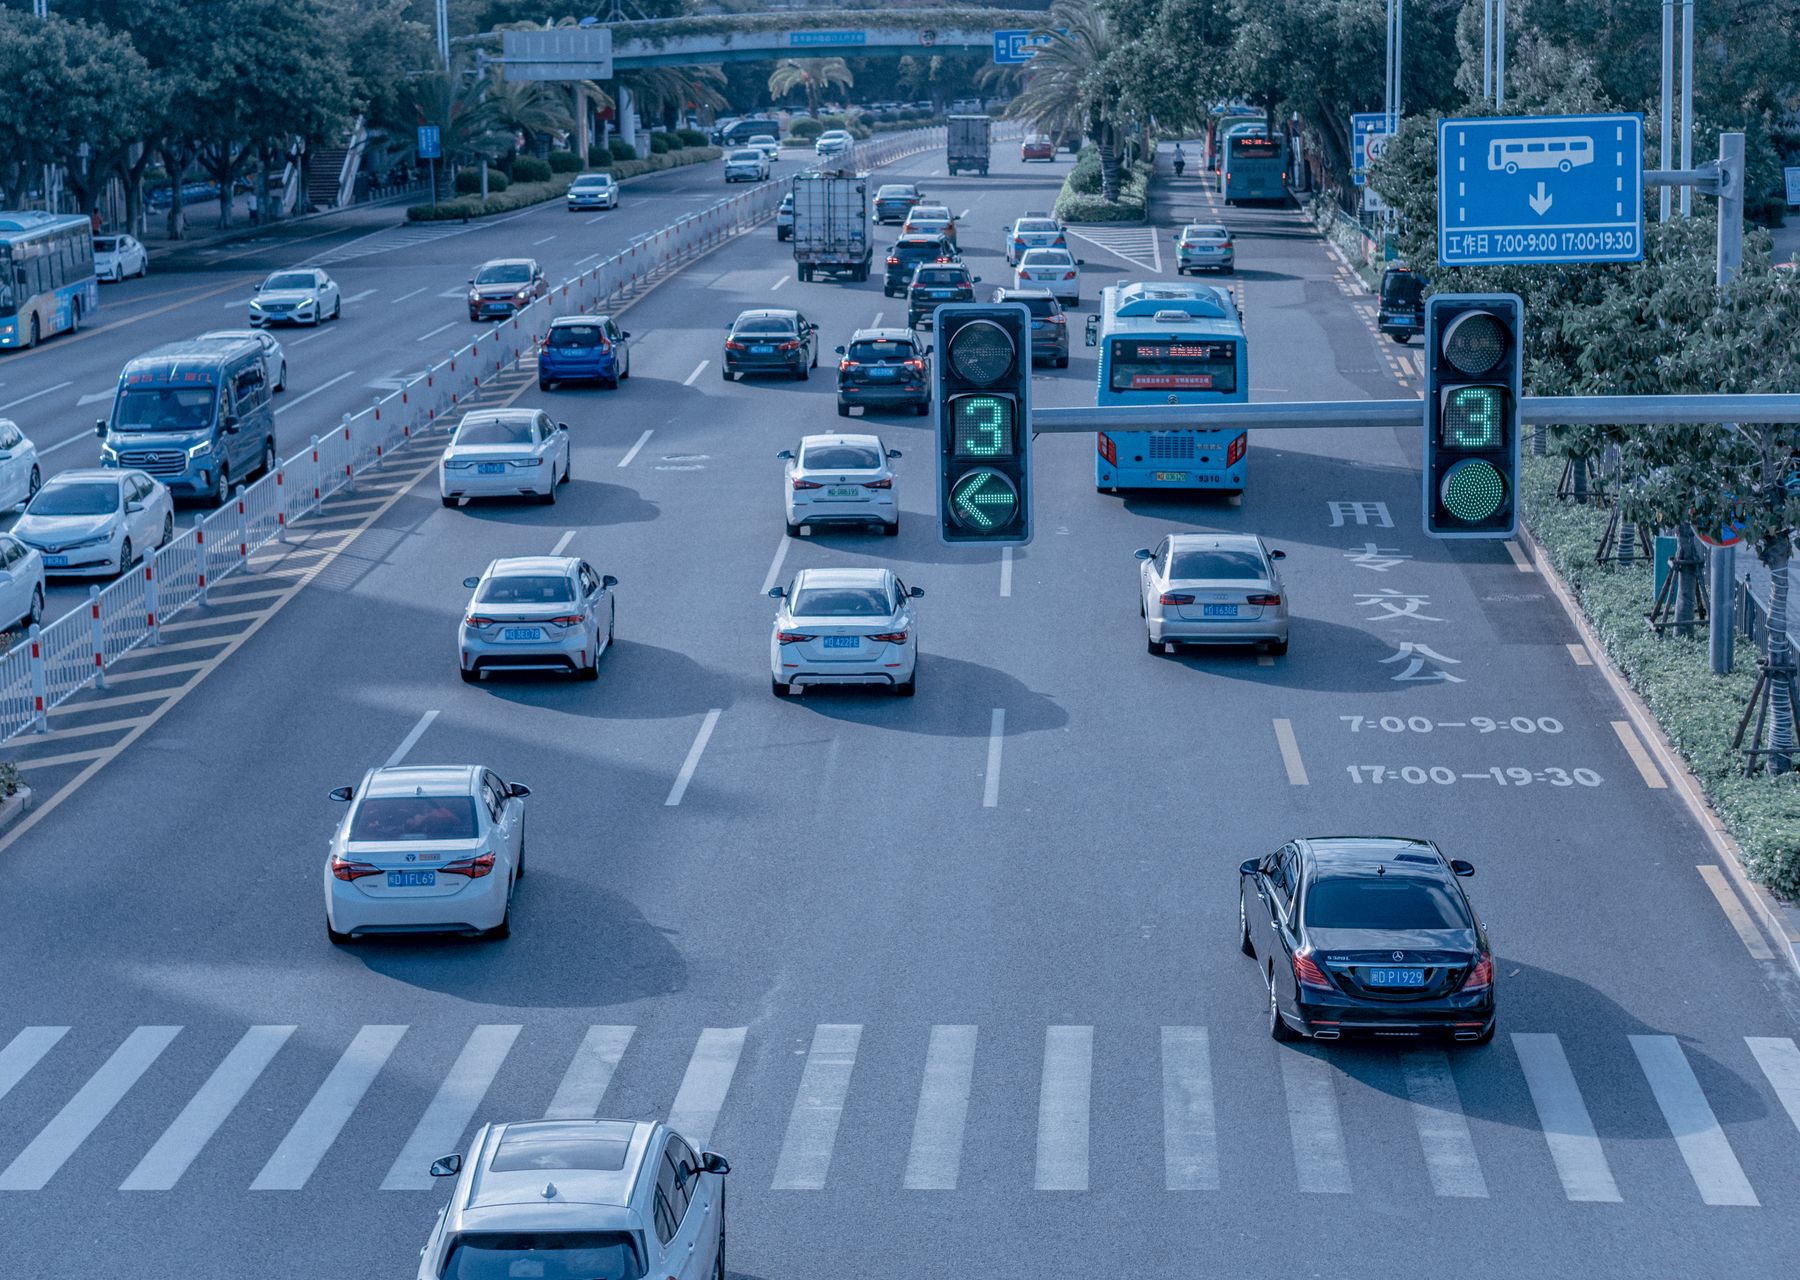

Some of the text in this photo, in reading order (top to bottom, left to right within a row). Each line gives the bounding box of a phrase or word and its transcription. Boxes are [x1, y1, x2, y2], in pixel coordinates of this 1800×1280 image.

[1448, 231, 1633, 255] 工作日 7:00-9:00 17:00-19:30
[966, 399, 1001, 455] 3
[1456, 390, 1491, 446] 3
[1198, 475, 1220, 483] 9310
